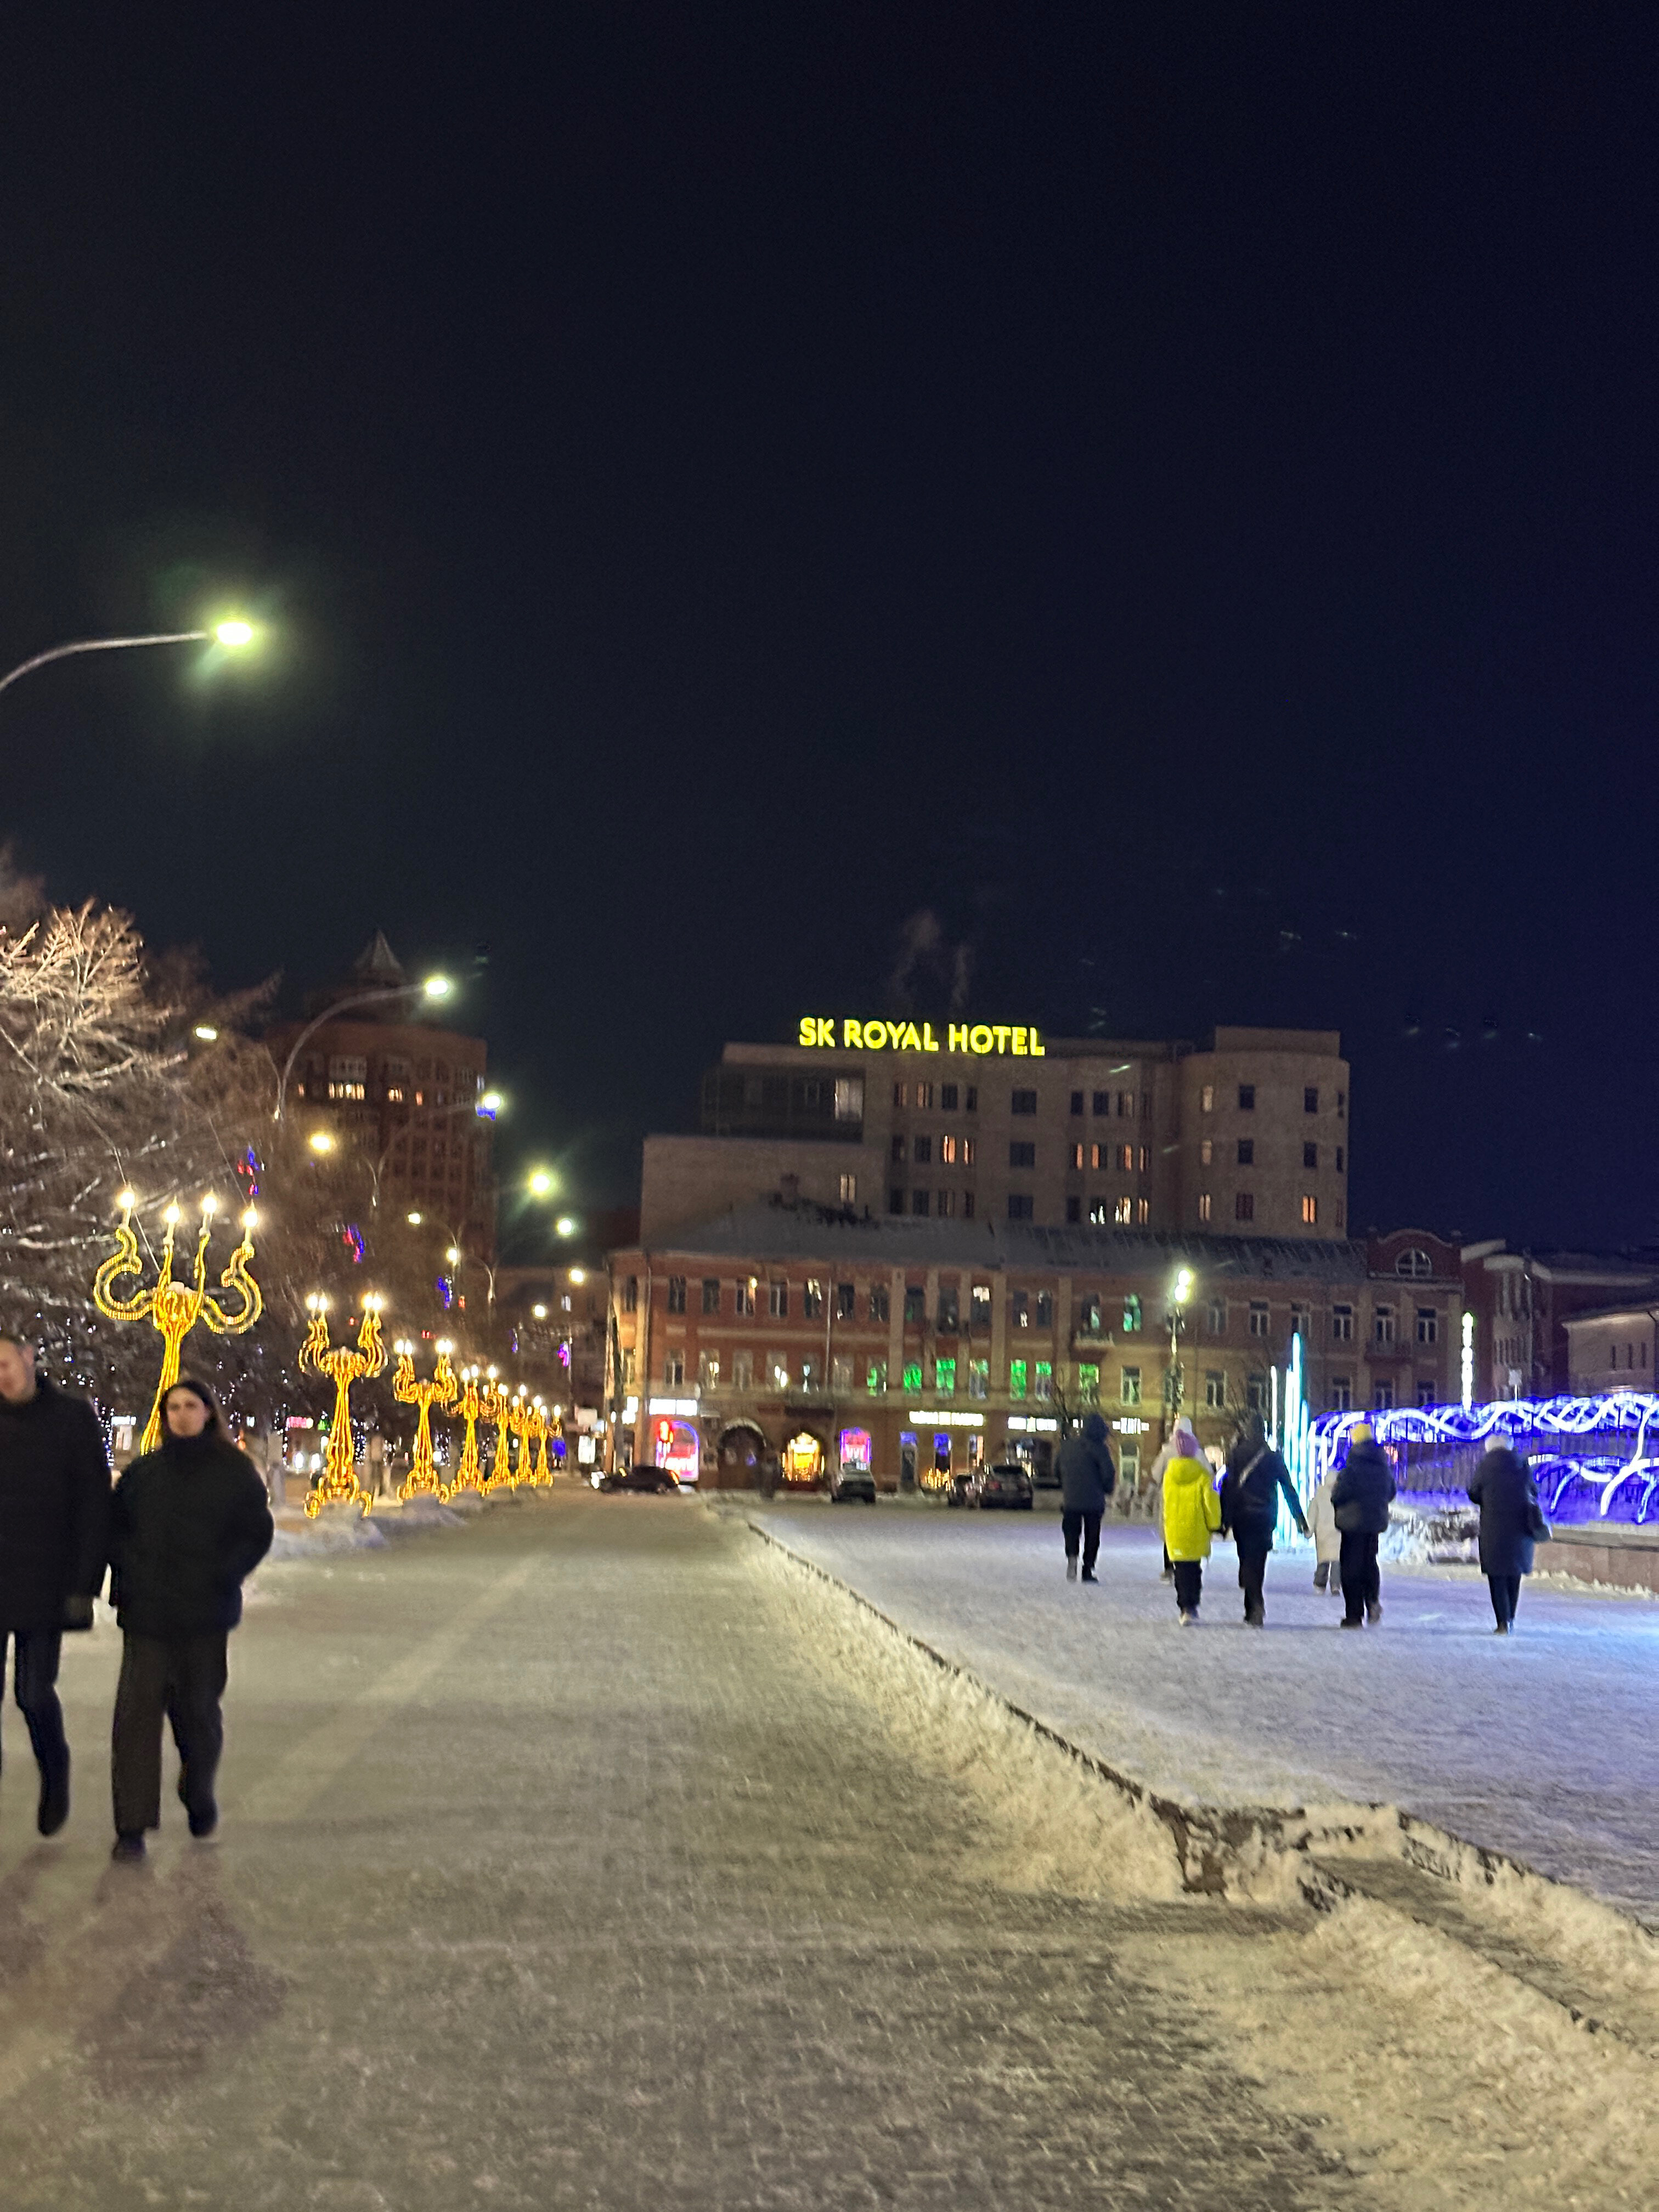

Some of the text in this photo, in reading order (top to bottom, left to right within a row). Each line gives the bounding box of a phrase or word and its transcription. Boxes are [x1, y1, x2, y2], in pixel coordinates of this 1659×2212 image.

[799, 1017, 1046, 1056] SK ROYAL HOTEL
